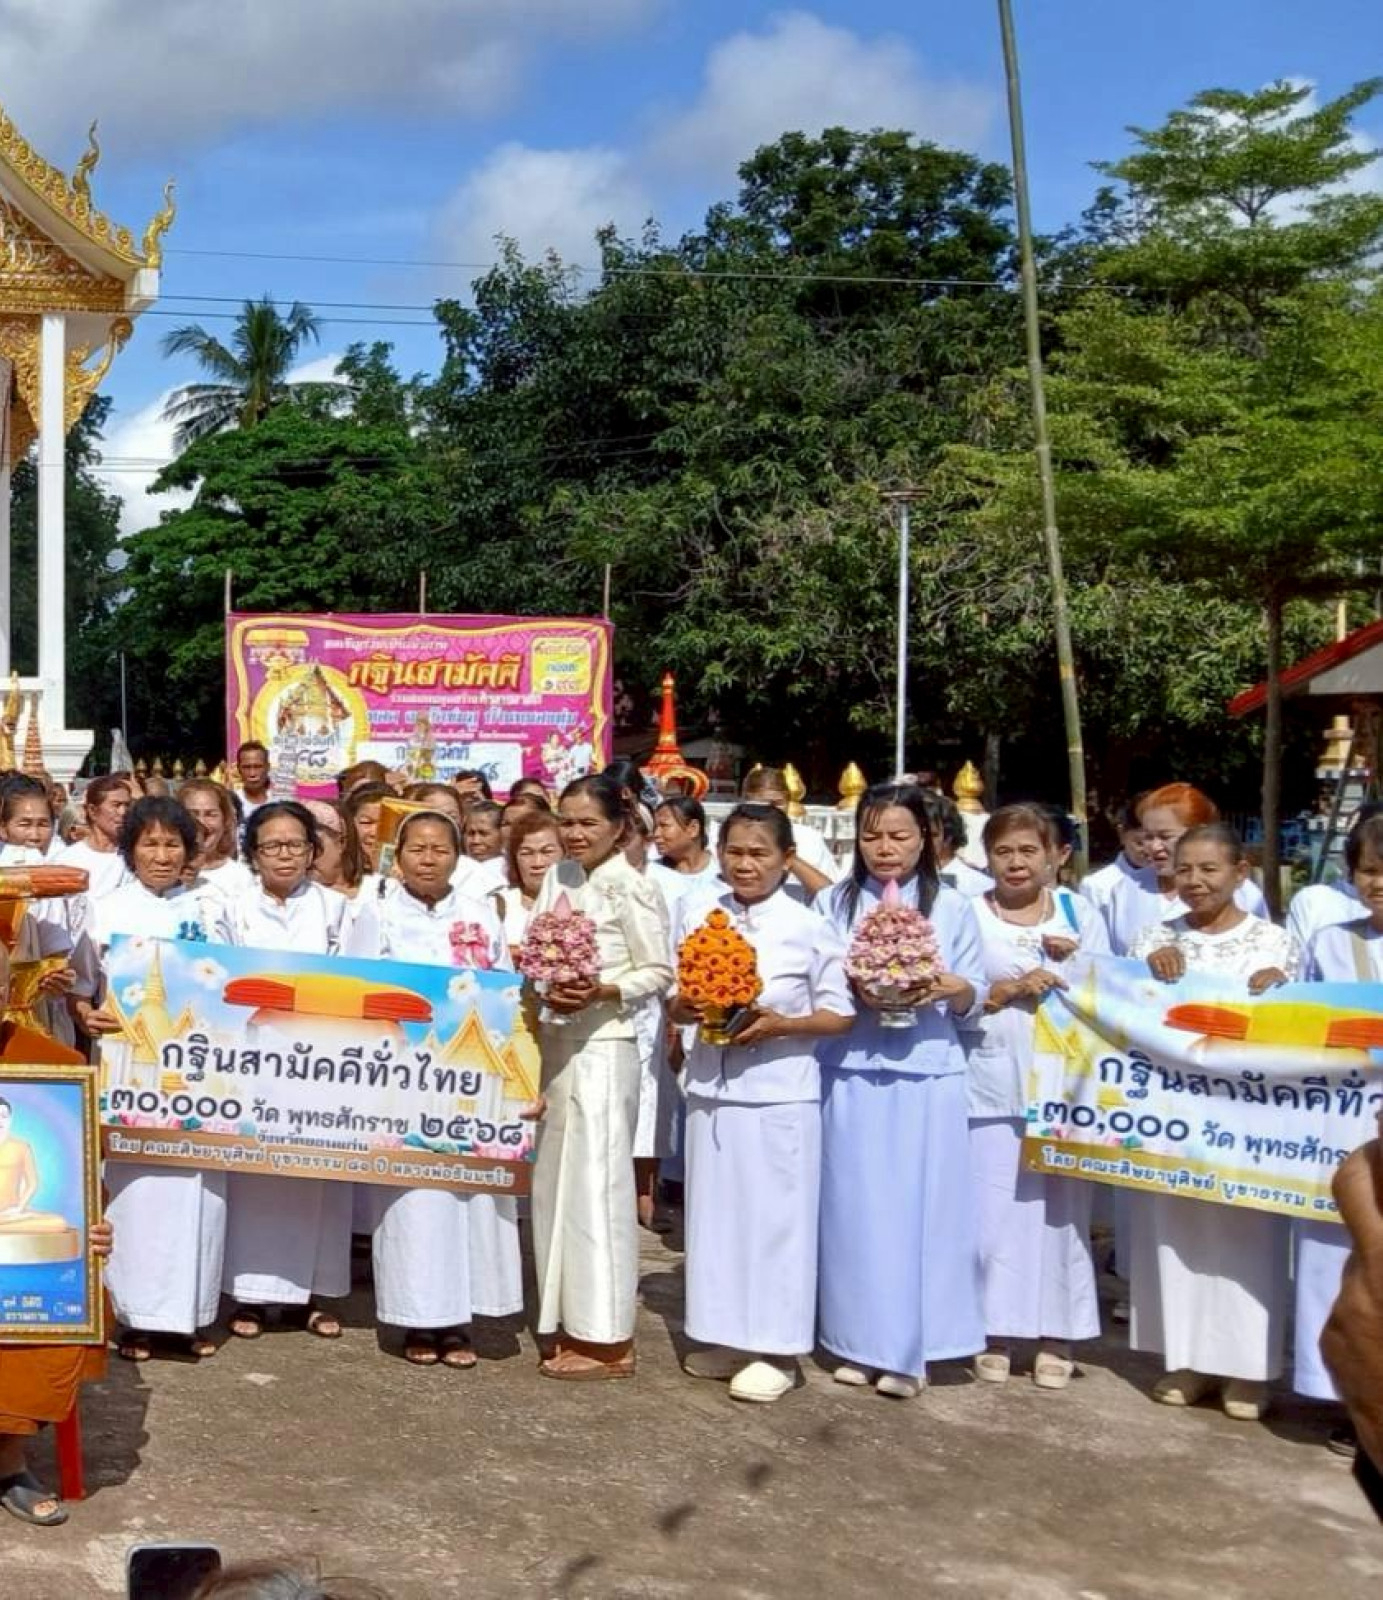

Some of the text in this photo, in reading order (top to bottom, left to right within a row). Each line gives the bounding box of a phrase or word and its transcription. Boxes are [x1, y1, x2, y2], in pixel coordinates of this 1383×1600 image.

[348, 653, 524, 695] กฐินสามัคคี
[161, 1032, 483, 1097] กฐินสามัคคีทั่วไทย
[109, 1088, 524, 1148] ๓๐,๐๐๐ วัด พุทธศักราช ๒๕๖๘
[1042, 1100, 1190, 1142] ๓๐,๐๐๐
[1202, 1120, 1236, 1150] วัด
[109, 1132, 141, 1154] โดย
[269, 1151, 345, 1173] บูชาธรรม
[376, 1158, 389, 1175] ปี
[1042, 1146, 1076, 1169] โดย
[1221, 1180, 1306, 1208] บูชาธรรม
